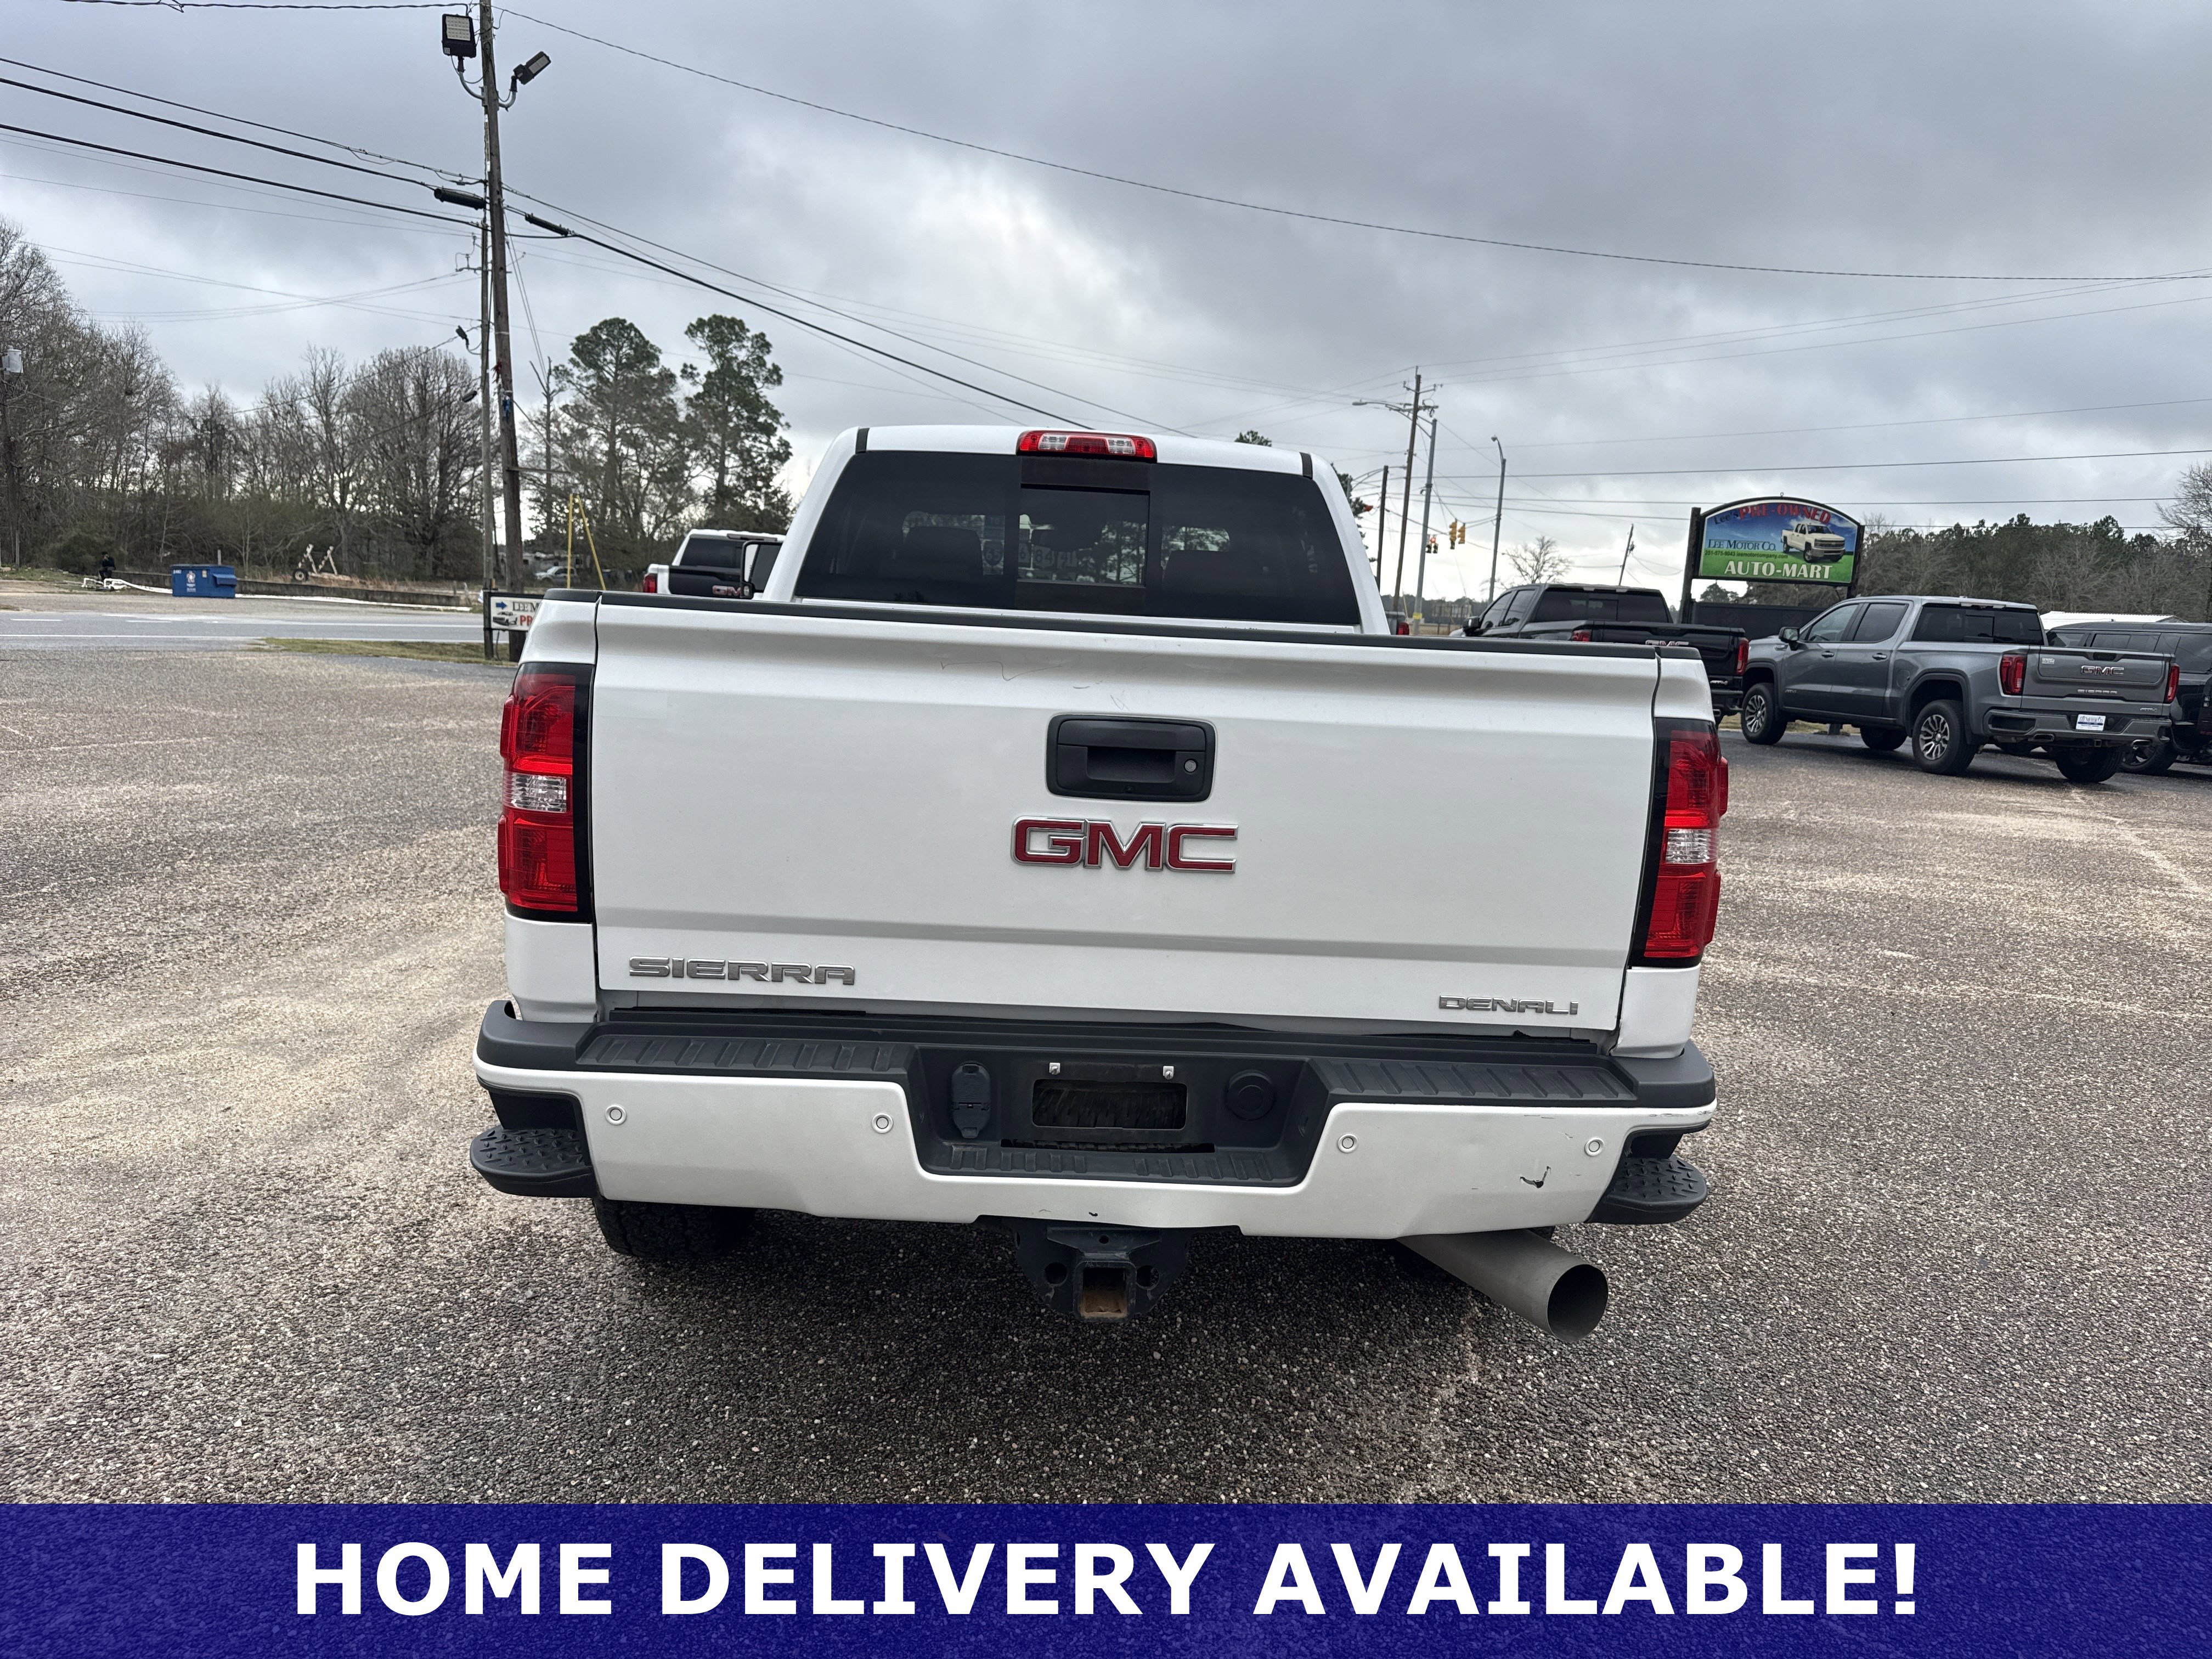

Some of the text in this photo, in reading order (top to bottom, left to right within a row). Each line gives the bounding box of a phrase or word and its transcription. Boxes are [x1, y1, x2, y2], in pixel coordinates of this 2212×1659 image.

[1739, 503, 1831, 524] PRE-OWNED
[1036, 549, 1053, 564] 84
[1724, 561, 1832, 579] AUTO-MART
[512, 601, 528, 612] LEE
[2081, 665, 2124, 675] GMC
[1011, 815, 1239, 874] GMC
[629, 955, 855, 985] SIERRA
[1438, 995, 1579, 1015] DENALI
